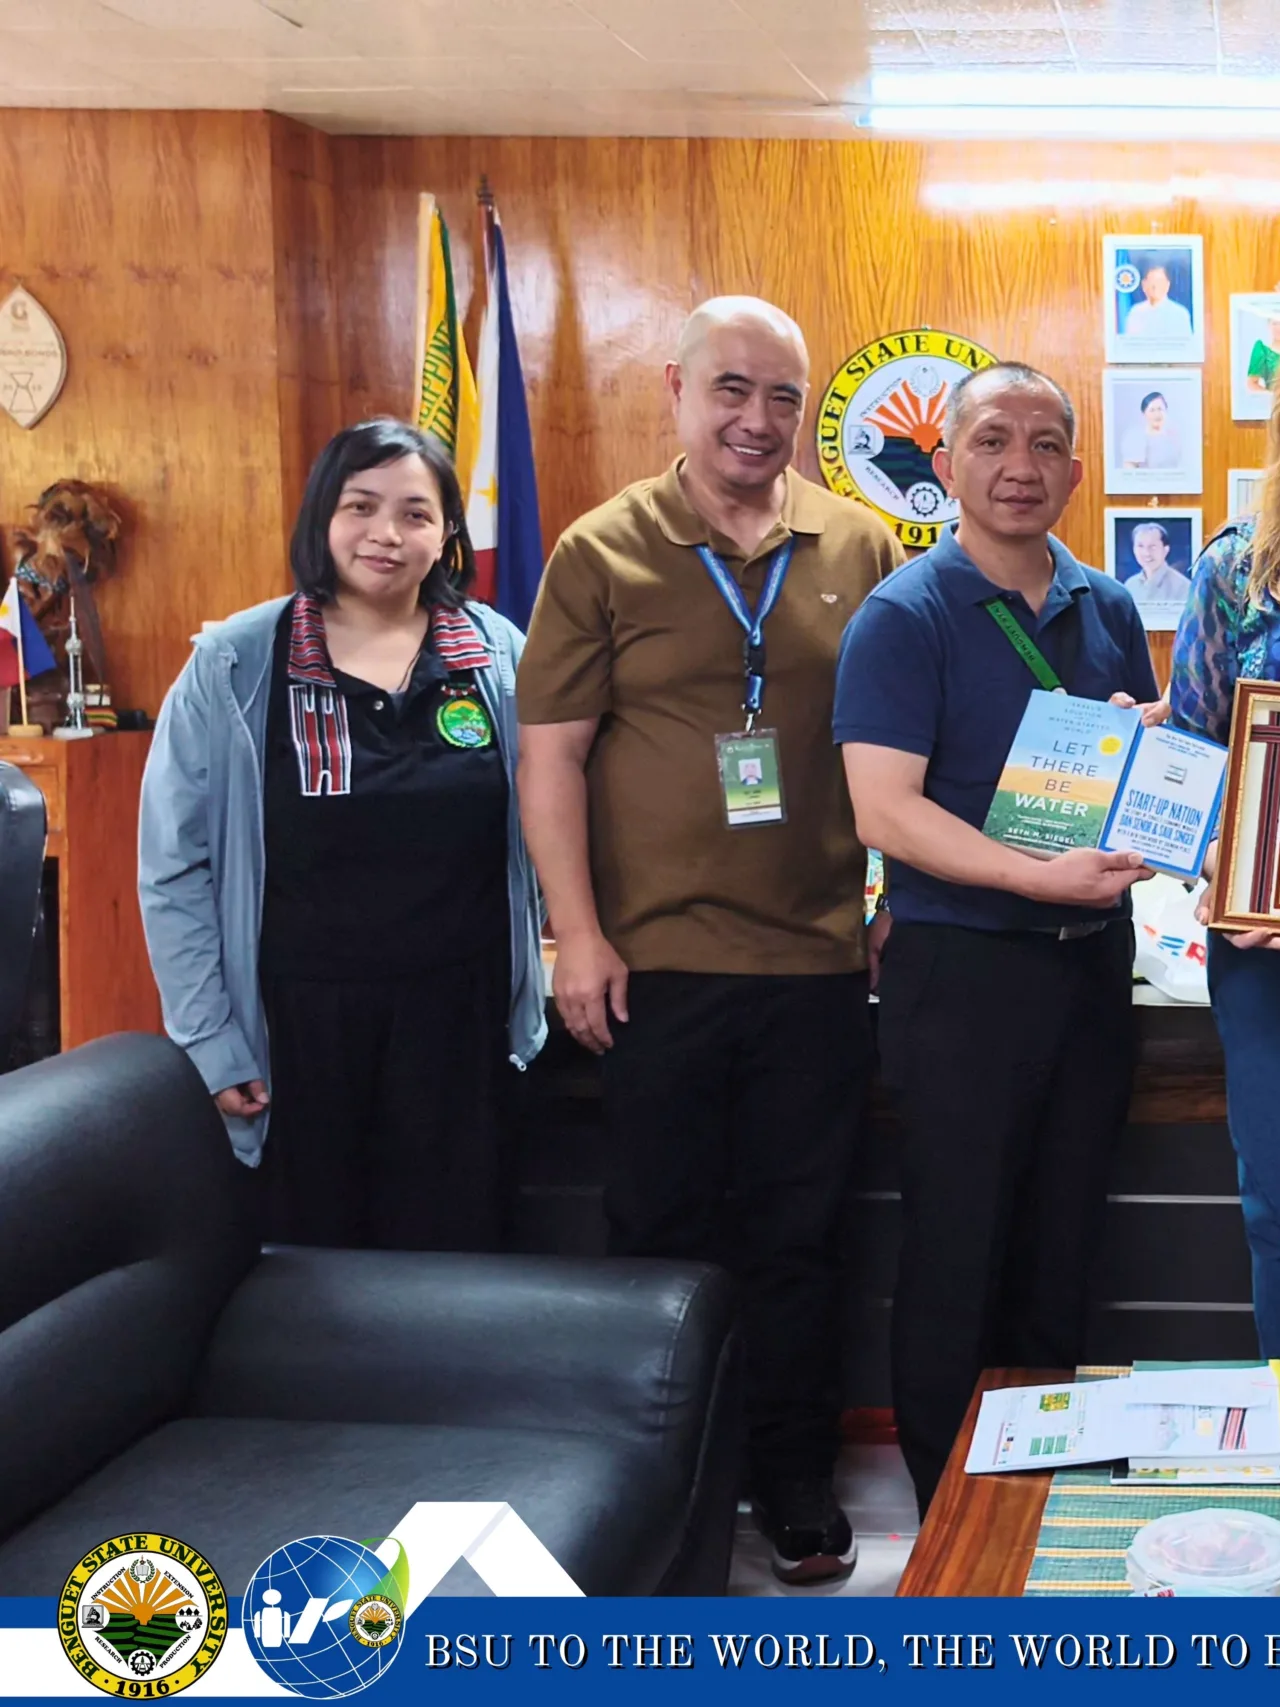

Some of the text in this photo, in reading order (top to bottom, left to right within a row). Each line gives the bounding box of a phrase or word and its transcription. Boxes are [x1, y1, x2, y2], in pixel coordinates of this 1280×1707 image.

[821, 335, 930, 502] ENGUET STATE
[865, 466, 900, 500] RESEARCH
[894, 522, 938, 545] 191
[1053, 740, 1092, 757] LET
[1031, 755, 1100, 778] THERE
[1044, 778, 1072, 794] BE
[1014, 792, 1089, 818] WATER
[1125, 789, 1170, 816] START-UP
[1169, 802, 1204, 827] NATION
